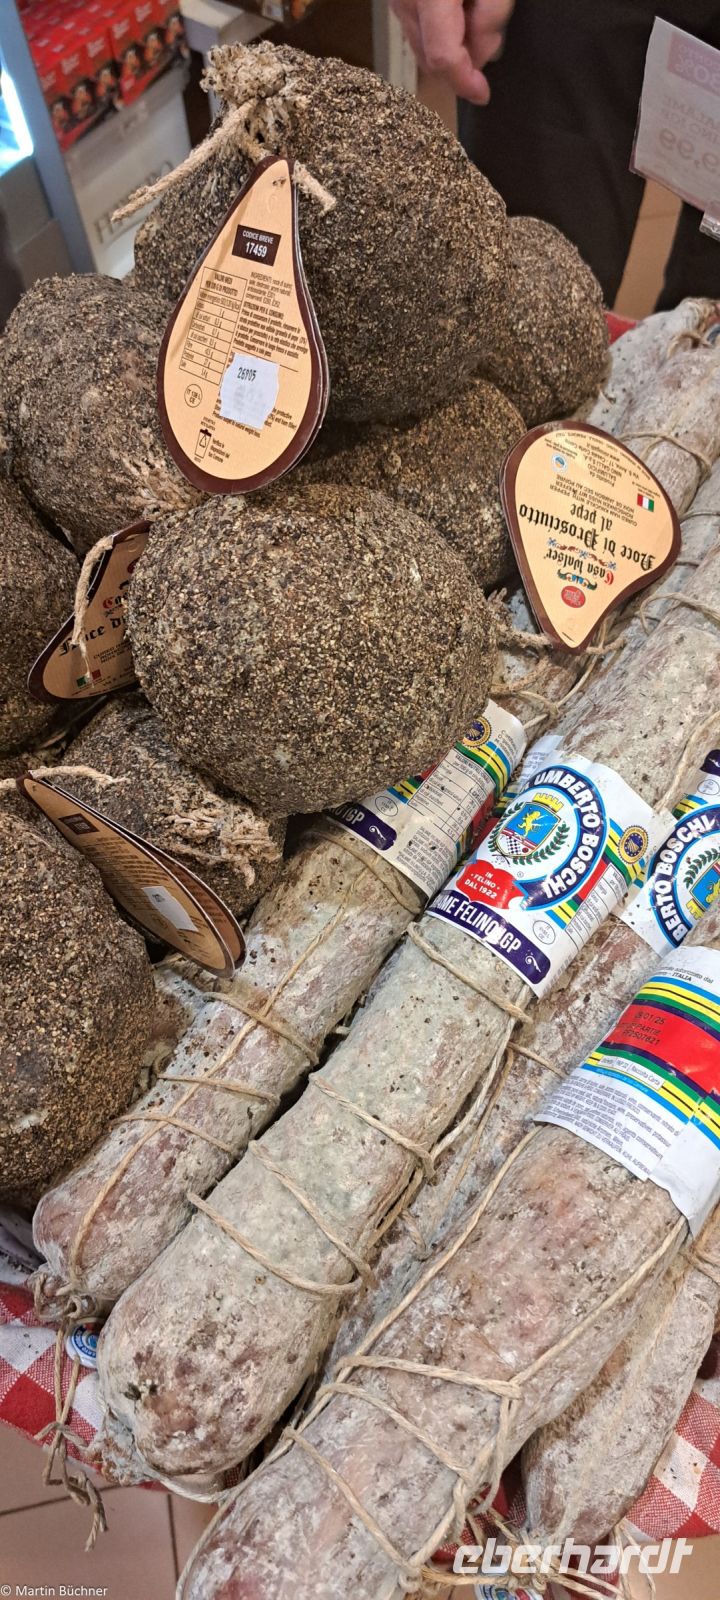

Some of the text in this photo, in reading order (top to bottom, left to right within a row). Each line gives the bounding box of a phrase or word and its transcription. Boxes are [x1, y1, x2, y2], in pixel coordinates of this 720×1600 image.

[242, 230, 274, 245] CODICE BREVE
[244, 242, 268, 258] 17459
[587, 464, 617, 481] SALUMIFICIO
[596, 461, 611, 471] GALLI
[610, 468, 623, 477] NINO
[555, 474, 575, 486] POIVRE
[575, 482, 583, 490] AU
[595, 474, 615, 486] Prodotto
[578, 490, 588, 499] MIT
[583, 486, 594, 495] SEC
[594, 491, 615, 505] JAMBON
[549, 484, 638, 527] CURED HAM KNUCKLE WITH PEPPER
[587, 494, 603, 505] NUSS
[623, 504, 635, 513] NOIX
[568, 502, 614, 533] al pepe
[516, 503, 657, 571] Noce di Prosciutto
[544, 547, 616, 585] Casa Walser
[342, 807, 366, 825] IGP
[535, 769, 601, 900] UMBERTO BOSCHI
[655, 814, 716, 876] BOSCHI
[473, 873, 497, 890] FELINO
[485, 871, 493, 880] IN
[464, 878, 498, 900] DAL 1922
[454, 900, 500, 937] FELINO
[654, 884, 689, 942] BERTO
[672, 971, 692, 982] ITALIA
